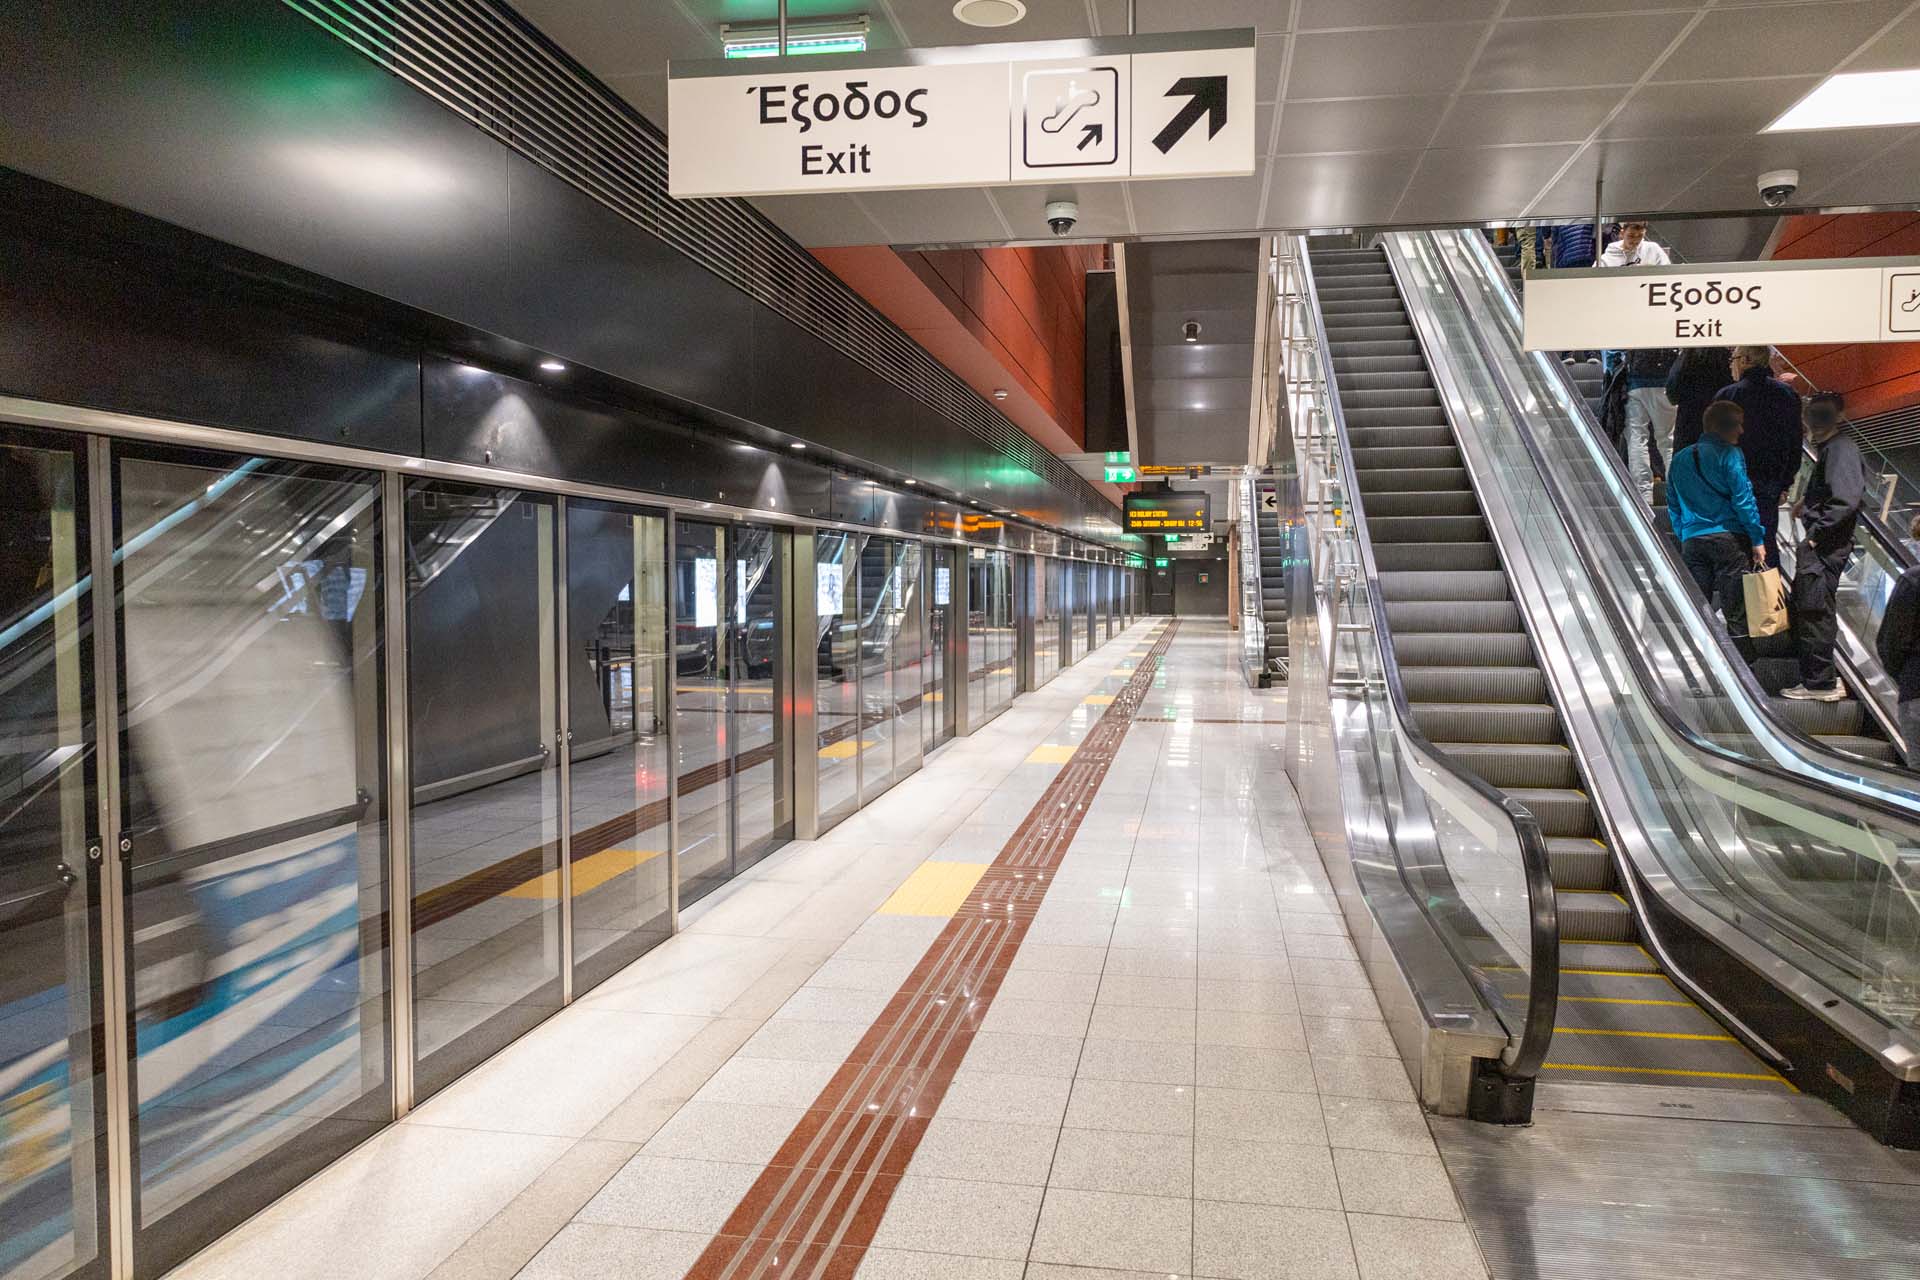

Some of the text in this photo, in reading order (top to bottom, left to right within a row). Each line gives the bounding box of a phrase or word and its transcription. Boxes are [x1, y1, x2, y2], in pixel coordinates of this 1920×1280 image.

[746, 81, 927, 133] Έξοδος
[801, 144, 871, 176] Exit
[1640, 281, 1762, 312] Έξοδος
[1675, 318, 1723, 338] Exit
